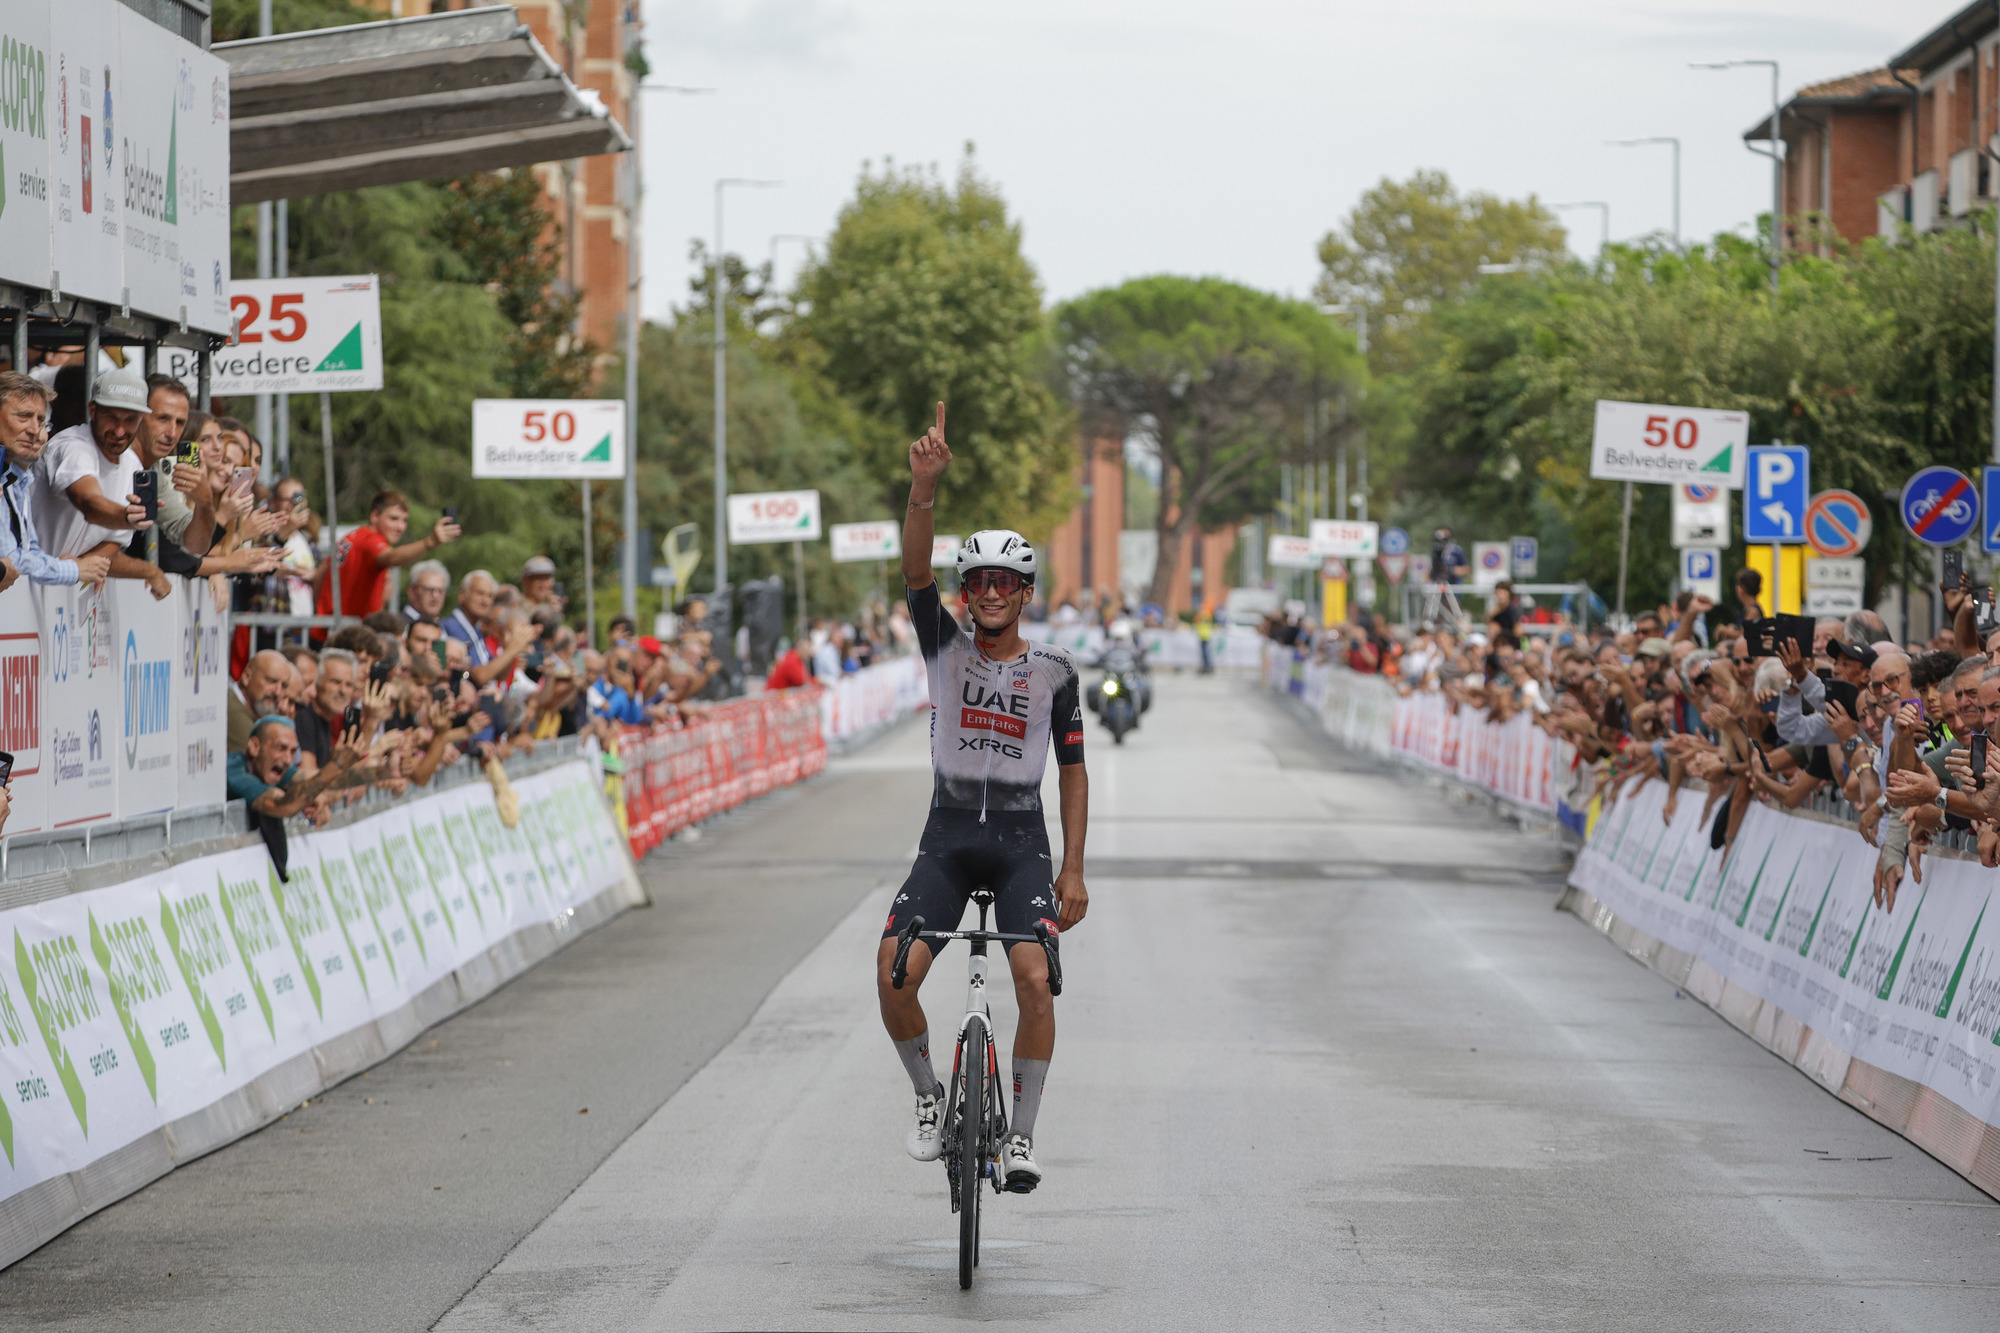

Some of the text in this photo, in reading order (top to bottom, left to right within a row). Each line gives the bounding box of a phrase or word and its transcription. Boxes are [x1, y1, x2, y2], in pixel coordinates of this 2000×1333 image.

[2, 34, 46, 140] COFOR
[20, 167, 46, 201] service
[124, 137, 164, 222] Belvedere
[226, 293, 307, 343] 25
[522, 411, 576, 442] 50
[1643, 415, 1699, 449] 50
[485, 446, 578, 463] Belvedere
[1605, 447, 1698, 471] Belvedere
[1758, 453, 1795, 499] P
[750, 499, 799, 519] 100
[1006, 536, 1018, 556] MET
[1042, 652, 1074, 675] Analog
[962, 680, 1030, 719] UAE
[966, 713, 1021, 733] Emirates
[958, 737, 1023, 760] XRG
[175, 892, 231, 979] COFOR
[104, 915, 172, 1006] COFOR
[32, 934, 101, 1033] COFOR
[225, 987, 247, 1017] service
[160, 1016, 190, 1049] service
[90, 1043, 119, 1078] service
[16, 1070, 50, 1104] service
